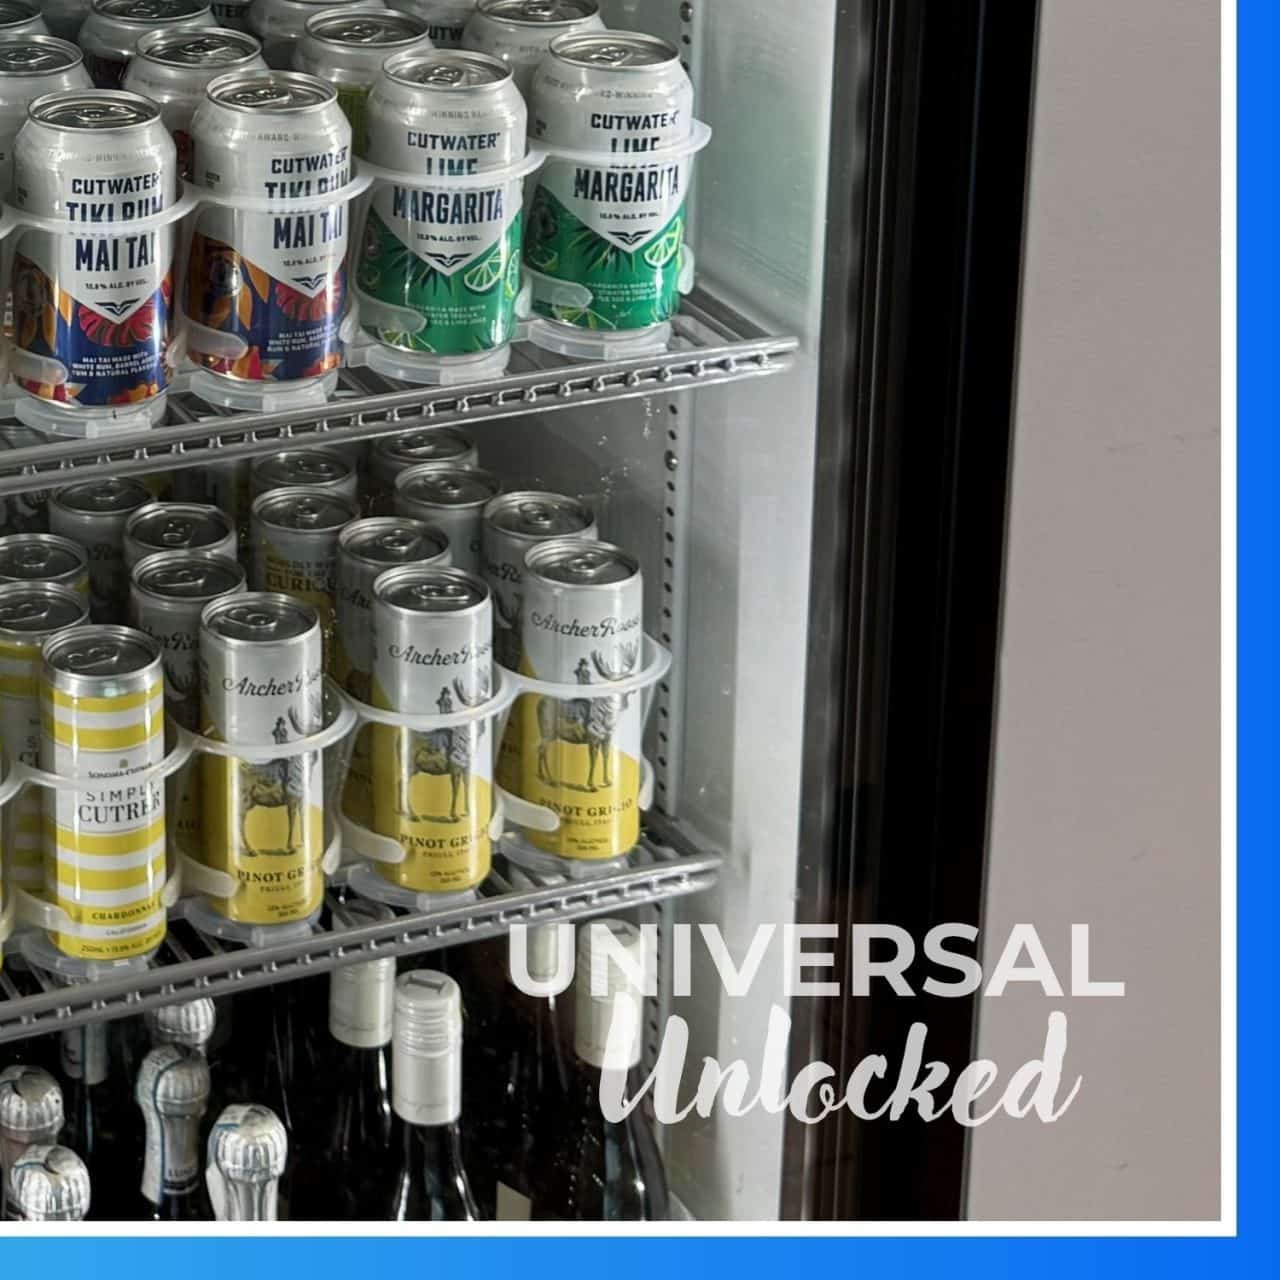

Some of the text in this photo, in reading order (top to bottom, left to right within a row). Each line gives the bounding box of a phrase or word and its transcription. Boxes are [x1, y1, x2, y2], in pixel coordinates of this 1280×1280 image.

[407, 131, 499, 152] CUTWATER
[271, 145, 350, 175] CUTWATER
[71, 172, 162, 196] CUTWATER
[574, 163, 680, 203] MARGARITA
[393, 185, 504, 225] MARGARITA
[273, 214, 315, 250] MAI
[75, 232, 155, 272] MAI TAI
[531, 610, 600, 637] Archer
[389, 643, 460, 668] Archer
[222, 675, 293, 698] Archer
[78, 791, 160, 825] CUTRER
[539, 796, 584, 817] PINOT
[399, 833, 444, 850] PINOT
[237, 869, 284, 885] PINOT
